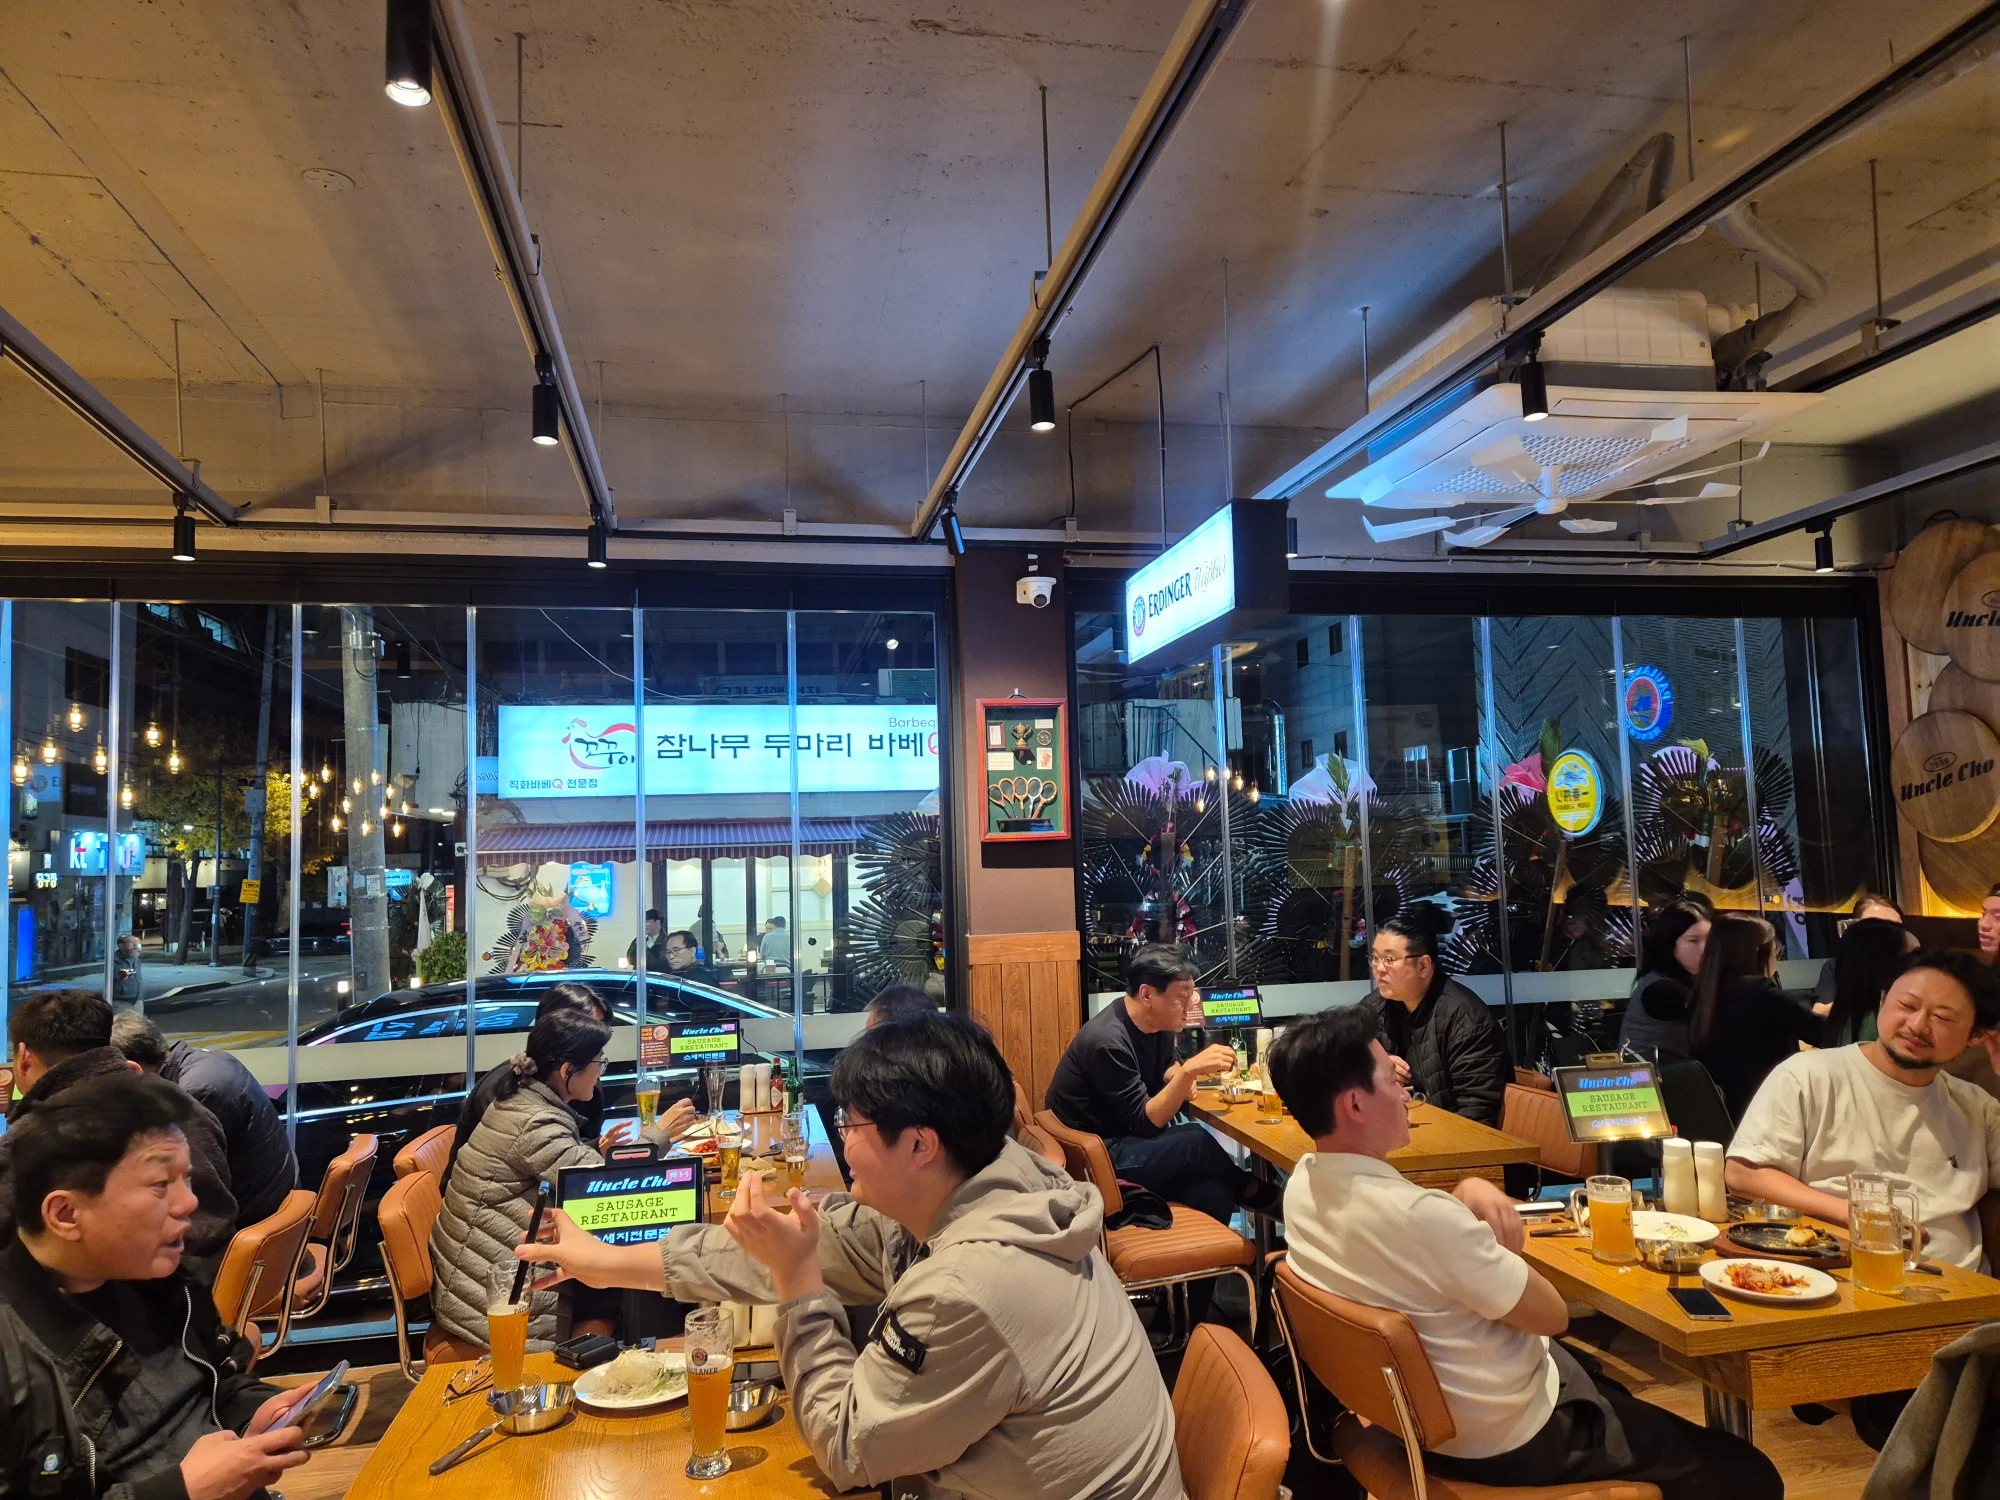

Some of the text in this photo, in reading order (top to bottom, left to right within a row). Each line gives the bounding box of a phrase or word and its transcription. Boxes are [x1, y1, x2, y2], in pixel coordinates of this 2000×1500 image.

[1148, 572, 1193, 619] ERDINGER
[656, 733, 751, 759] 참나무
[763, 733, 852, 758] 두마리
[509, 778, 598, 790] 직화바베Q 전문점
[1901, 758, 1994, 801] Uncle Cho
[70, 838, 88, 868] kt
[1210, 992, 1232, 1000] Uncle
[681, 1027, 708, 1036] Uncle
[680, 1043, 729, 1051] RESTAURANT
[687, 1037, 721, 1045] SAUSAGE
[1579, 1077, 1614, 1089] Uncle
[1590, 1092, 1637, 1103] SAUSAGE
[1581, 1101, 1648, 1113] RESTAURANT
[586, 1177, 639, 1193] Uncle
[596, 1196, 664, 1212] SAUSAGE
[580, 1207, 678, 1226] RESTAURANT
